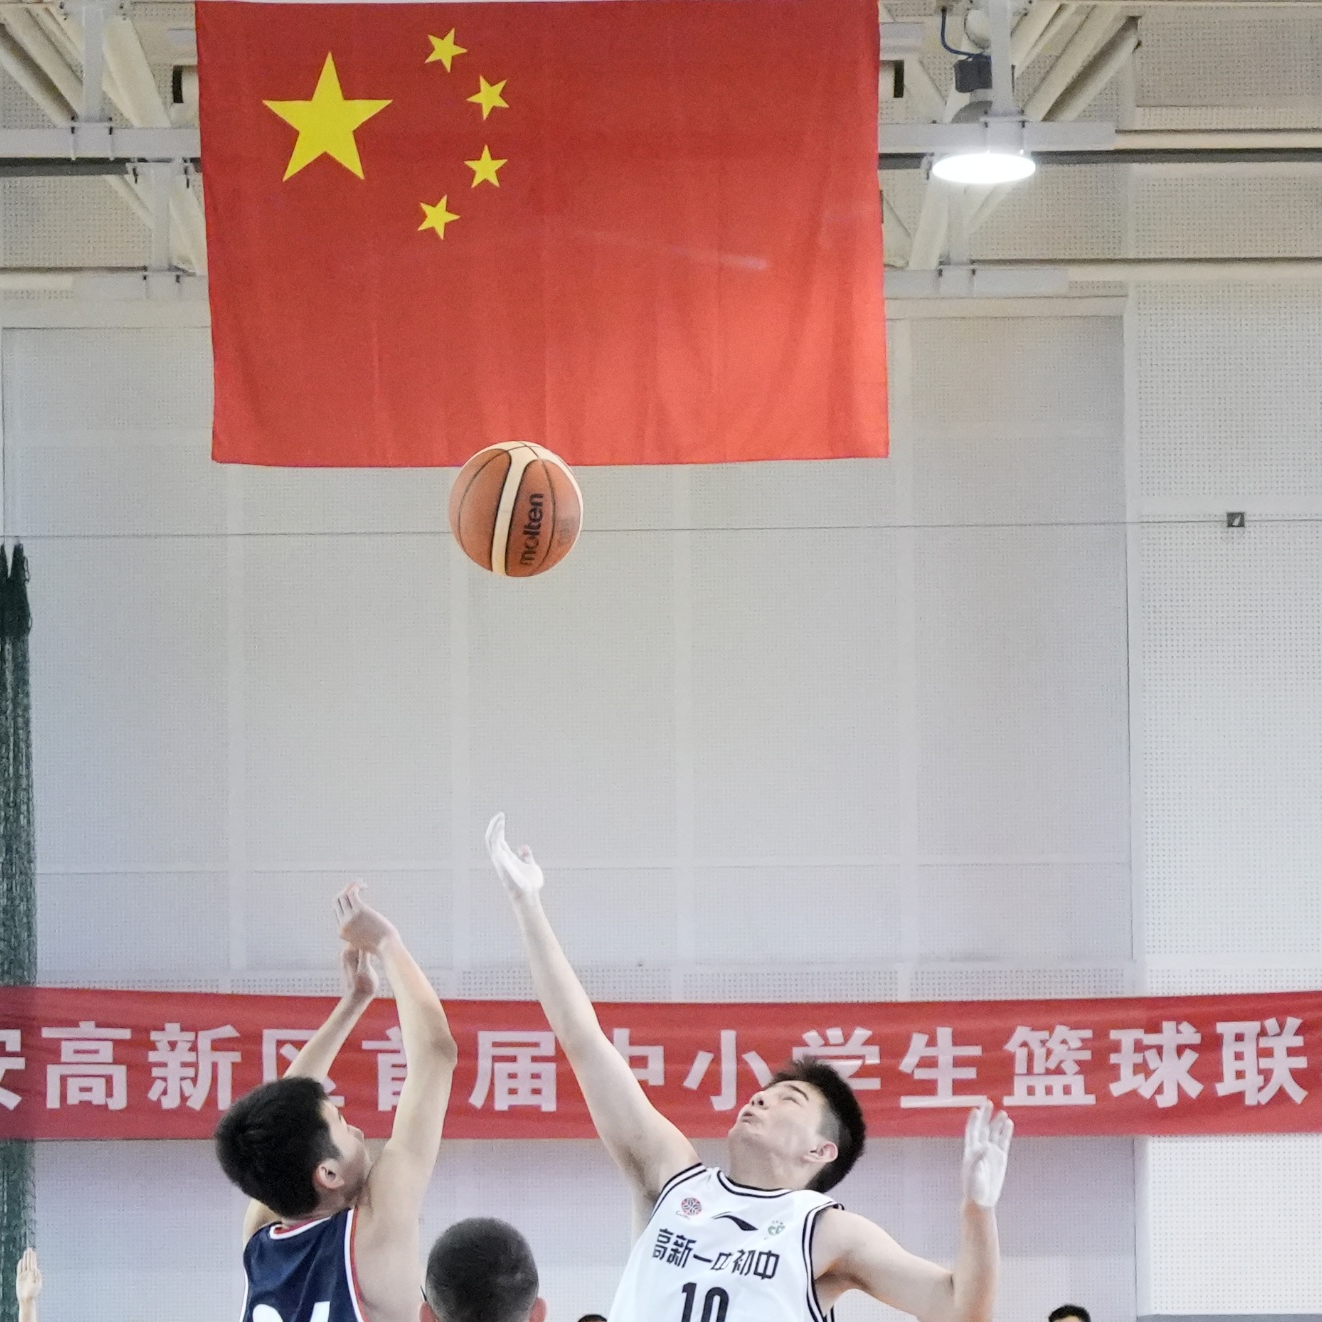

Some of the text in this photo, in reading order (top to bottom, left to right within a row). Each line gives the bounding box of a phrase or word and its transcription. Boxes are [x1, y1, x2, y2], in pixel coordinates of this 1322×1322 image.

[519, 492, 544, 566] molten
[652, 1228, 780, 1281] 高新一中初中
